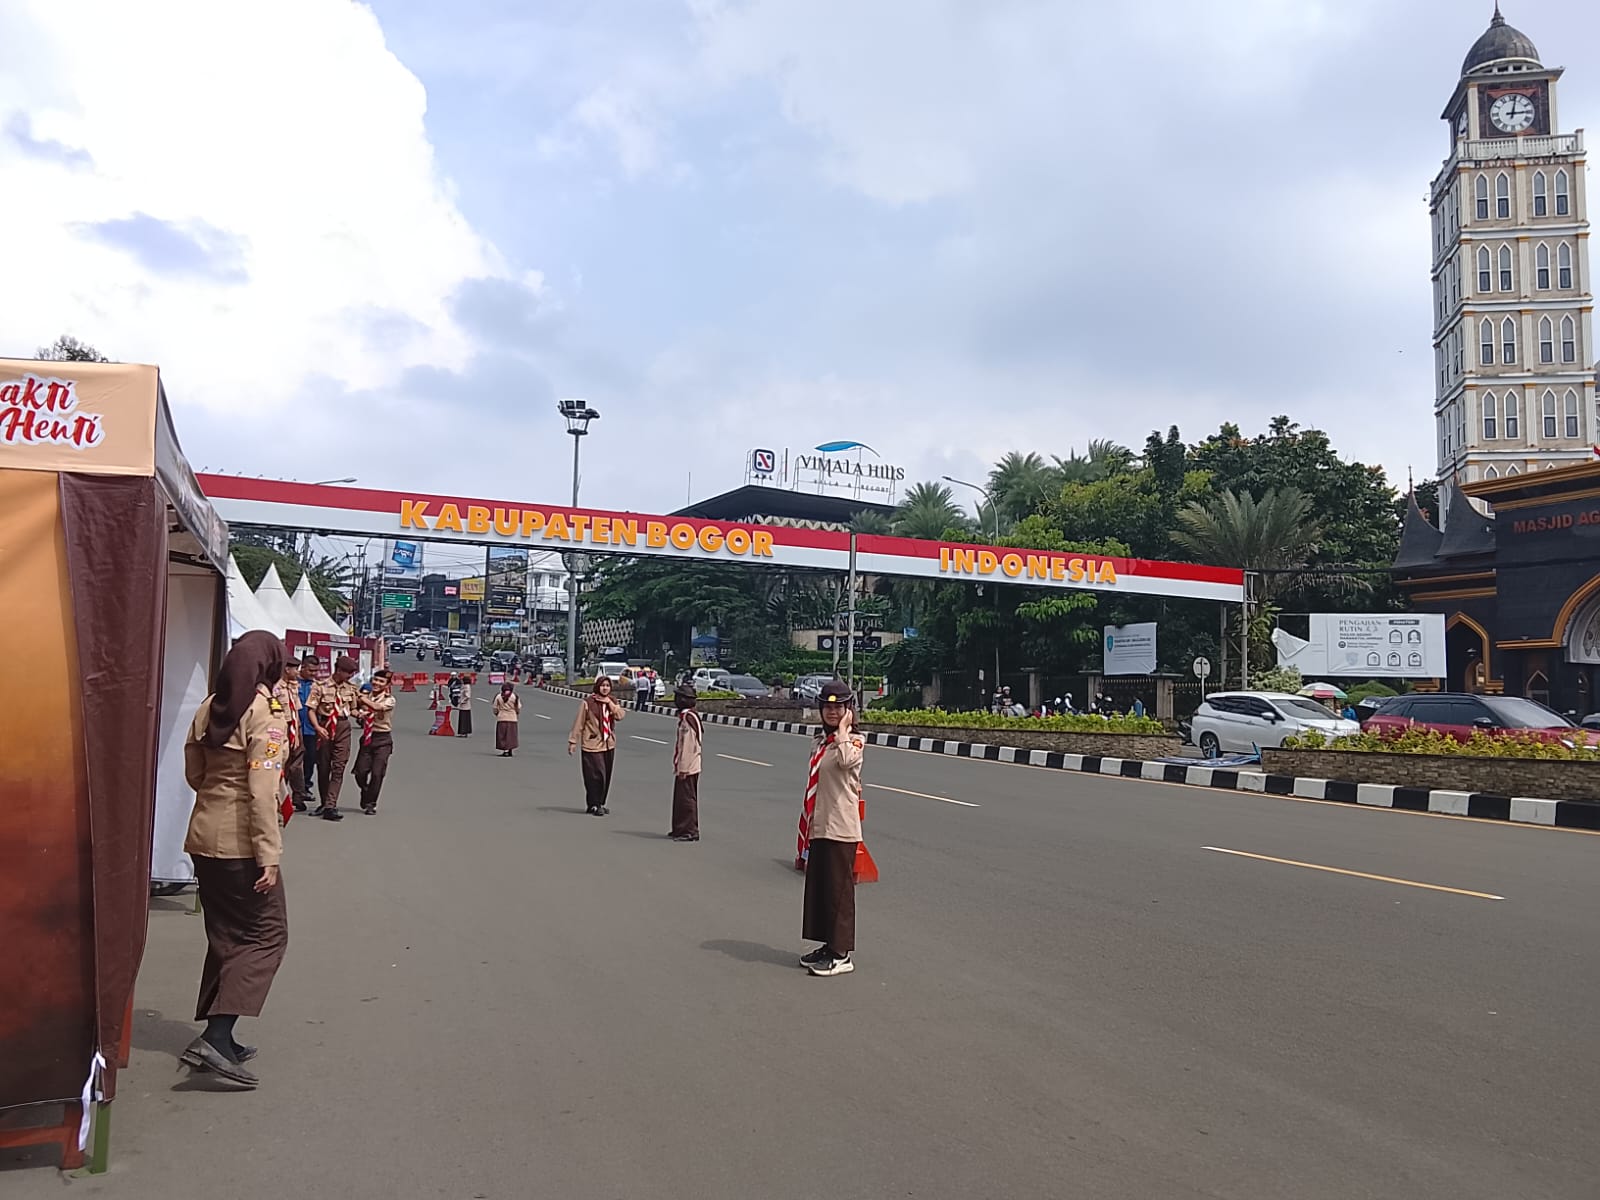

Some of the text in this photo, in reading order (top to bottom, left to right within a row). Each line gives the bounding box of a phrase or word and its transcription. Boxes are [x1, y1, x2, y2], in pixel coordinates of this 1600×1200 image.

[400, 499, 775, 558] KABUPATEN BOGOR
[1512, 513, 1573, 534] MASJID
[939, 547, 1117, 584] INDONESIA
